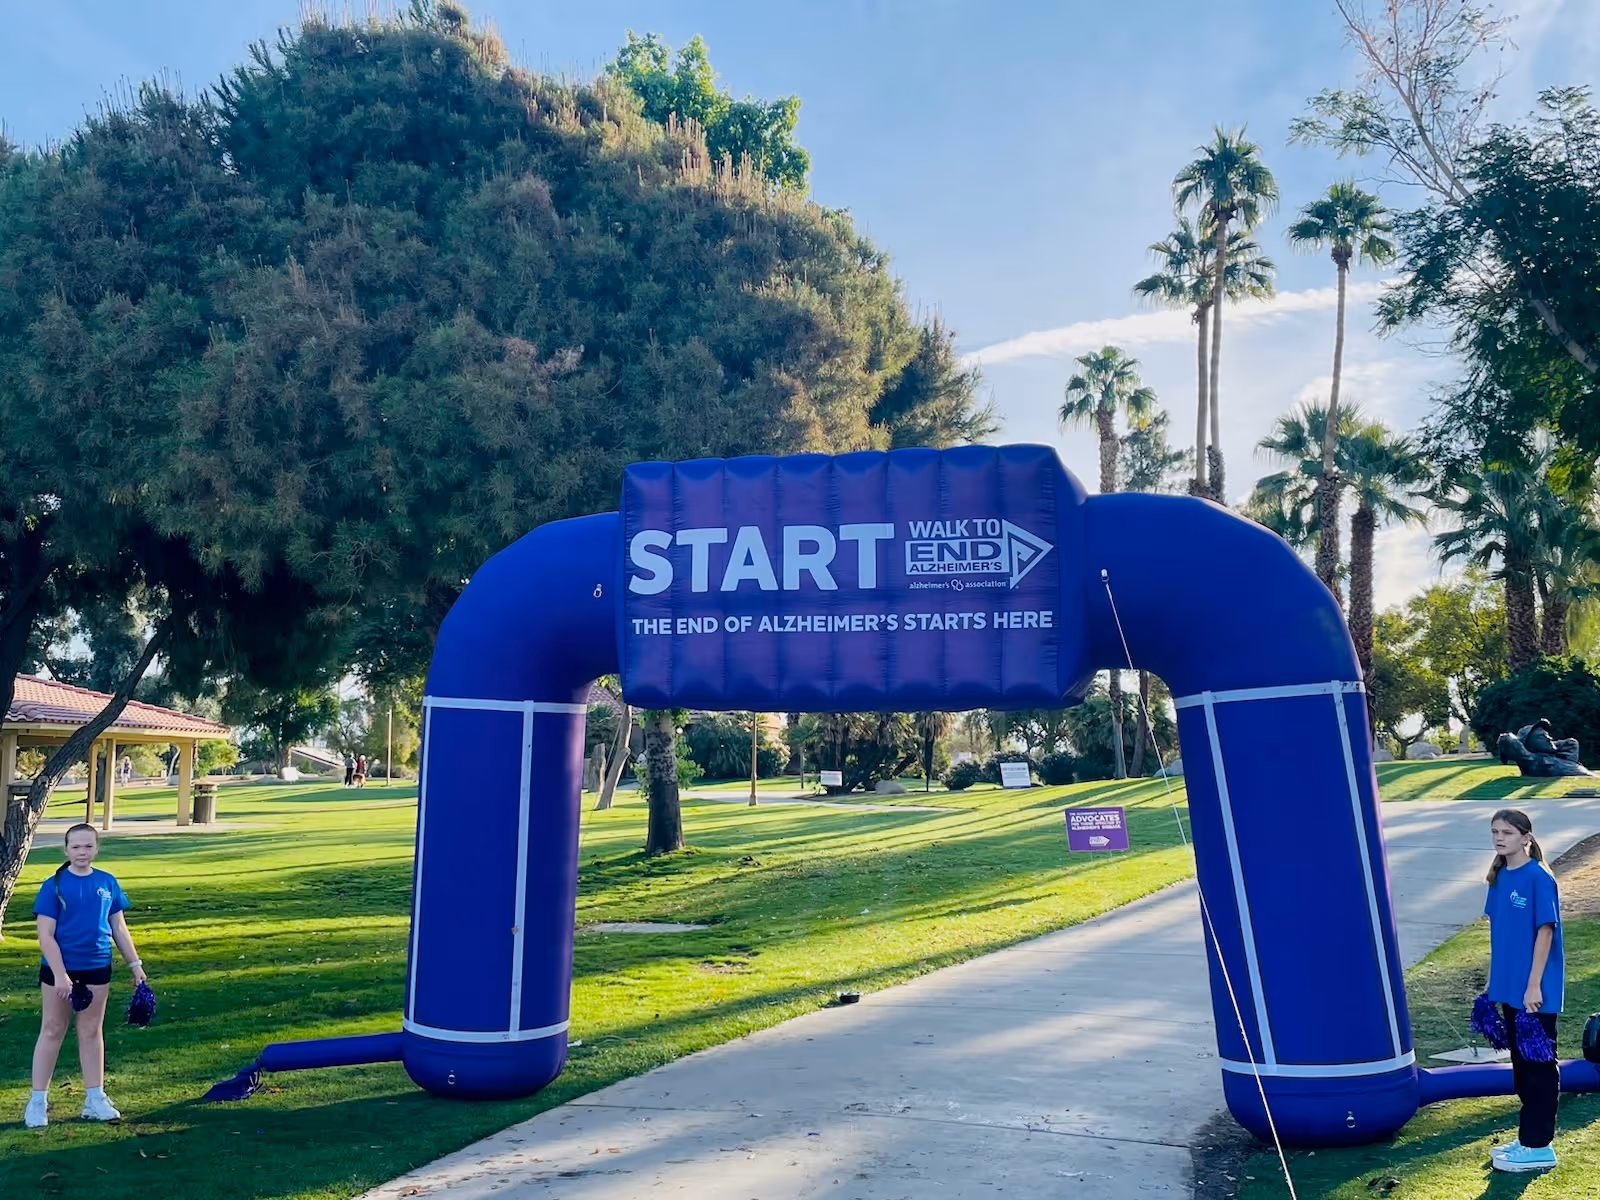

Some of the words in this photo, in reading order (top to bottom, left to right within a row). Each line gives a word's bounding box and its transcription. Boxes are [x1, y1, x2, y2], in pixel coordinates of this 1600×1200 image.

[908, 519, 969, 538] WALK
[972, 518, 1000, 536] TO
[628, 522, 895, 595] START
[910, 540, 1002, 562] END
[909, 561, 1002, 573] ALZHEIMER'S
[908, 580, 950, 590] alzheimer's
[965, 579, 1007, 588] association
[632, 618, 672, 635] THE
[676, 617, 719, 634] END
[724, 616, 753, 633] OF
[758, 614, 899, 632] ALZHEIMER'S
[903, 612, 987, 631] STARTS
[993, 611, 1053, 629] HERE
[1070, 814, 1120, 823] ADVOCATES
